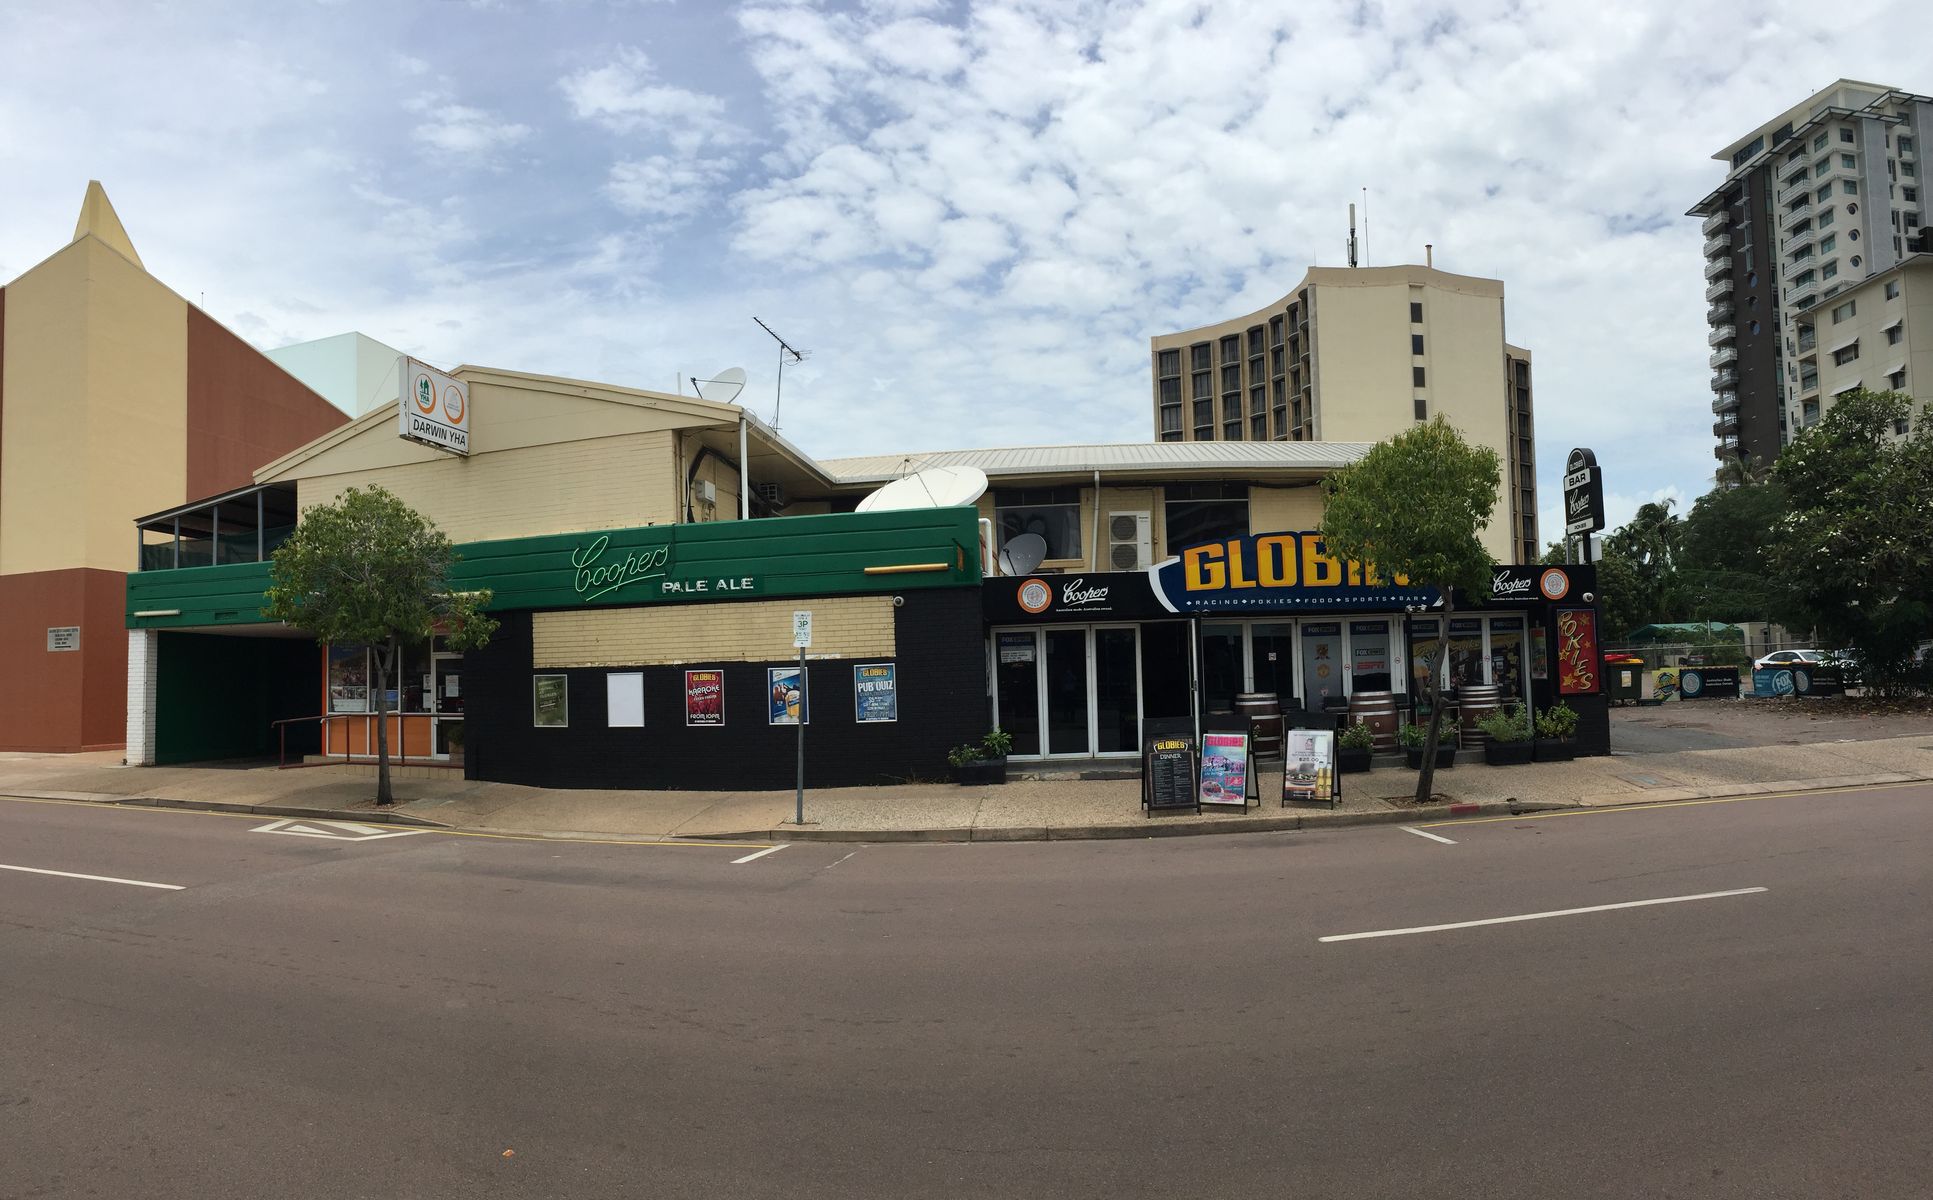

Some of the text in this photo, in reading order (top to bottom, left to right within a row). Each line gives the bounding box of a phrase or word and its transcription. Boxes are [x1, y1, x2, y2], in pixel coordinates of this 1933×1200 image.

[414, 419, 466, 446] DARWIN YHA
[1569, 472, 1586, 486] BAR
[572, 536, 669, 601] Coopers
[662, 578, 754, 593] PALE ALE
[1493, 570, 1532, 595] Coopers
[1063, 578, 1108, 606] Coopers
[1560, 611, 1593, 690] POKIES
[1357, 661, 1384, 670] ESPN
[858, 680, 893, 692] PUB QUIZ
[1776, 673, 1792, 688] FOX
[689, 684, 720, 696] KARAOKE
[1158, 740, 1185, 750] GLOBIES
